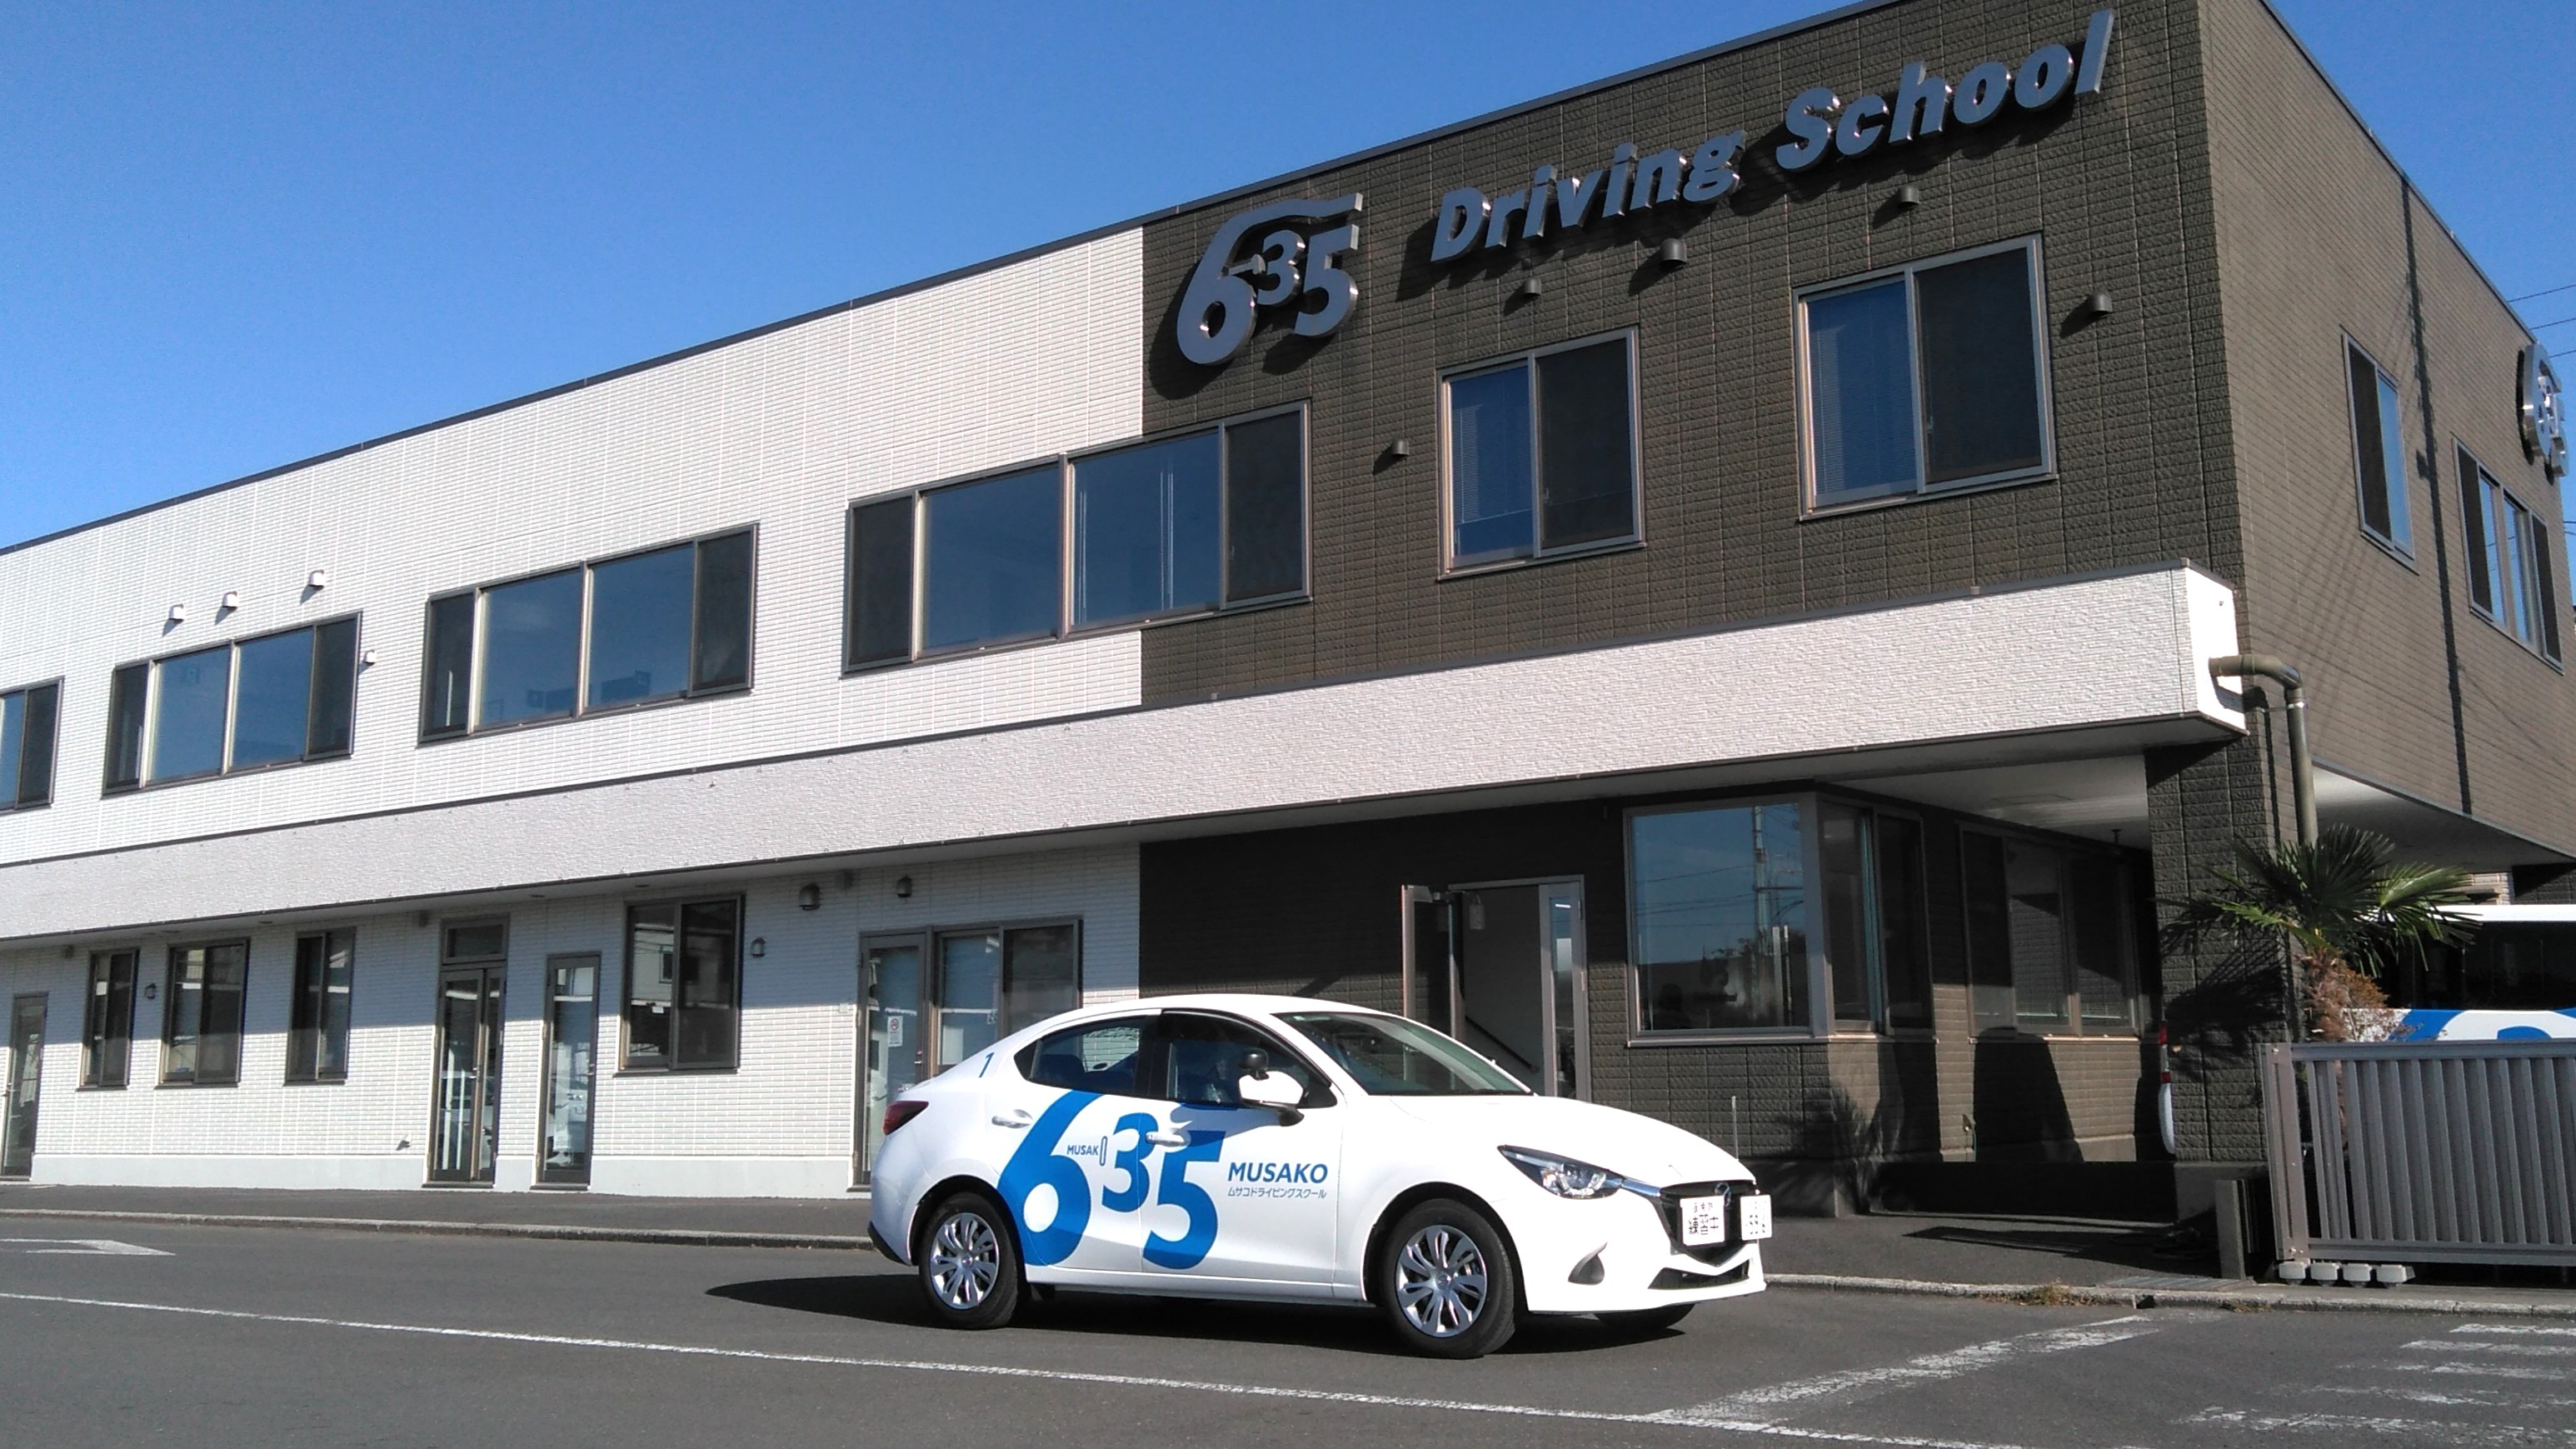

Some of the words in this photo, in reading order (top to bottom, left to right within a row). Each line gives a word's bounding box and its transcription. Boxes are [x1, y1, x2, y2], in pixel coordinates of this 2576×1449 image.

[1430, 129, 1745, 262] Driving
[1775, 8, 2115, 172] School
[1176, 192, 1363, 365] 635
[997, 1090, 1238, 1269] 635
[1228, 1162, 1328, 1184] MUSAKO
[1228, 1187, 1327, 1198] ムサコドライビングスクール
